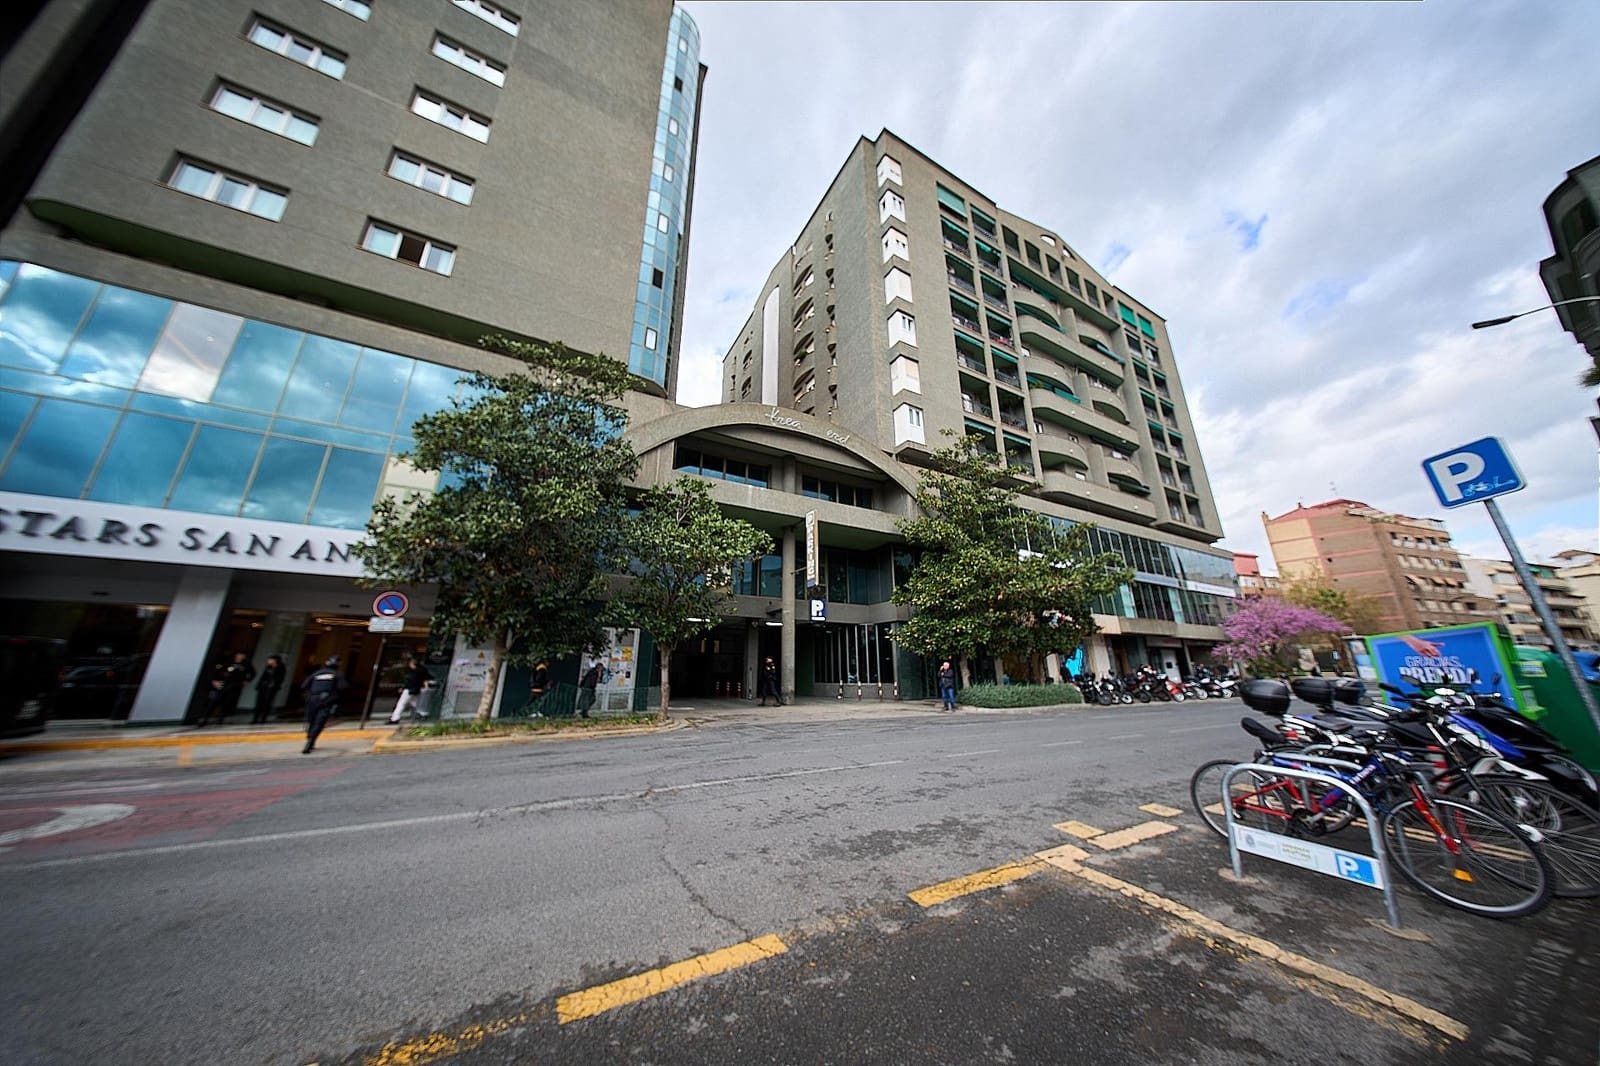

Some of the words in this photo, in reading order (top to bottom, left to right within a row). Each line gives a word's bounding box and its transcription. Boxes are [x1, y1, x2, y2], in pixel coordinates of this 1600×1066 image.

[1429, 452, 1485, 501] P
[179, 527, 280, 558] SAN
[290, 539, 354, 563] AN
[1337, 855, 1360, 877] P
